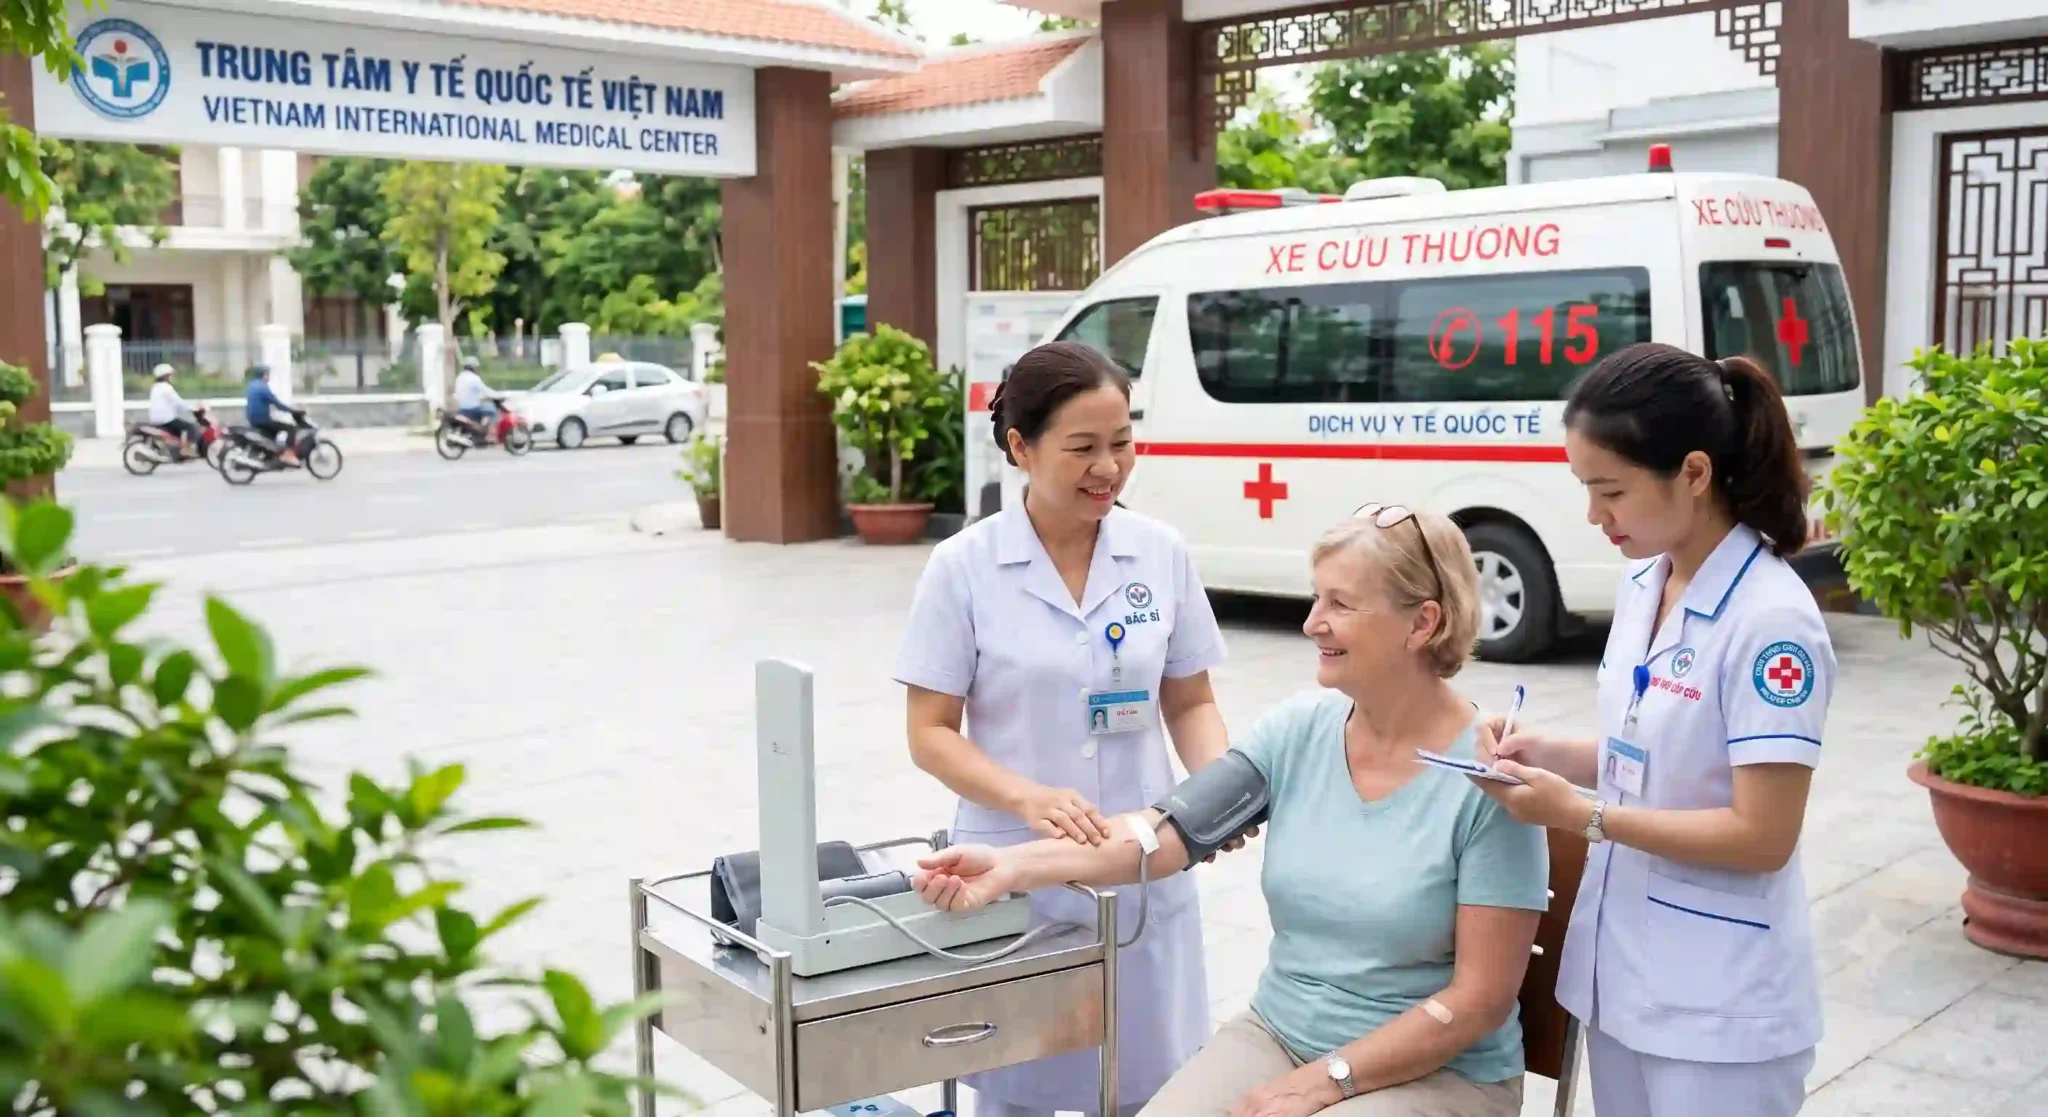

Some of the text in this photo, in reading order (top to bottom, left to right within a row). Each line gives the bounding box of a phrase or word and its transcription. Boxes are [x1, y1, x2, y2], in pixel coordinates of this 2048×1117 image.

[195, 41, 724, 120] TRUNG TÂM Y TẾ QUỐC TẾ VIỆT NAM
[203, 96, 718, 156] VIETNAM INTERNATIONAL MEDICAL CENTER
[1690, 198, 1722, 225] XE
[1266, 243, 1306, 273] XE
[1402, 223, 1560, 264] THƯƠNG
[1496, 305, 1599, 365] 115
[1308, 415, 1354, 438] DỊCH
[1360, 415, 1386, 437] VỤ
[1393, 415, 1404, 433] Y
[1513, 405, 1541, 434] TẾ
[1125, 611, 1147, 625] BÁC
